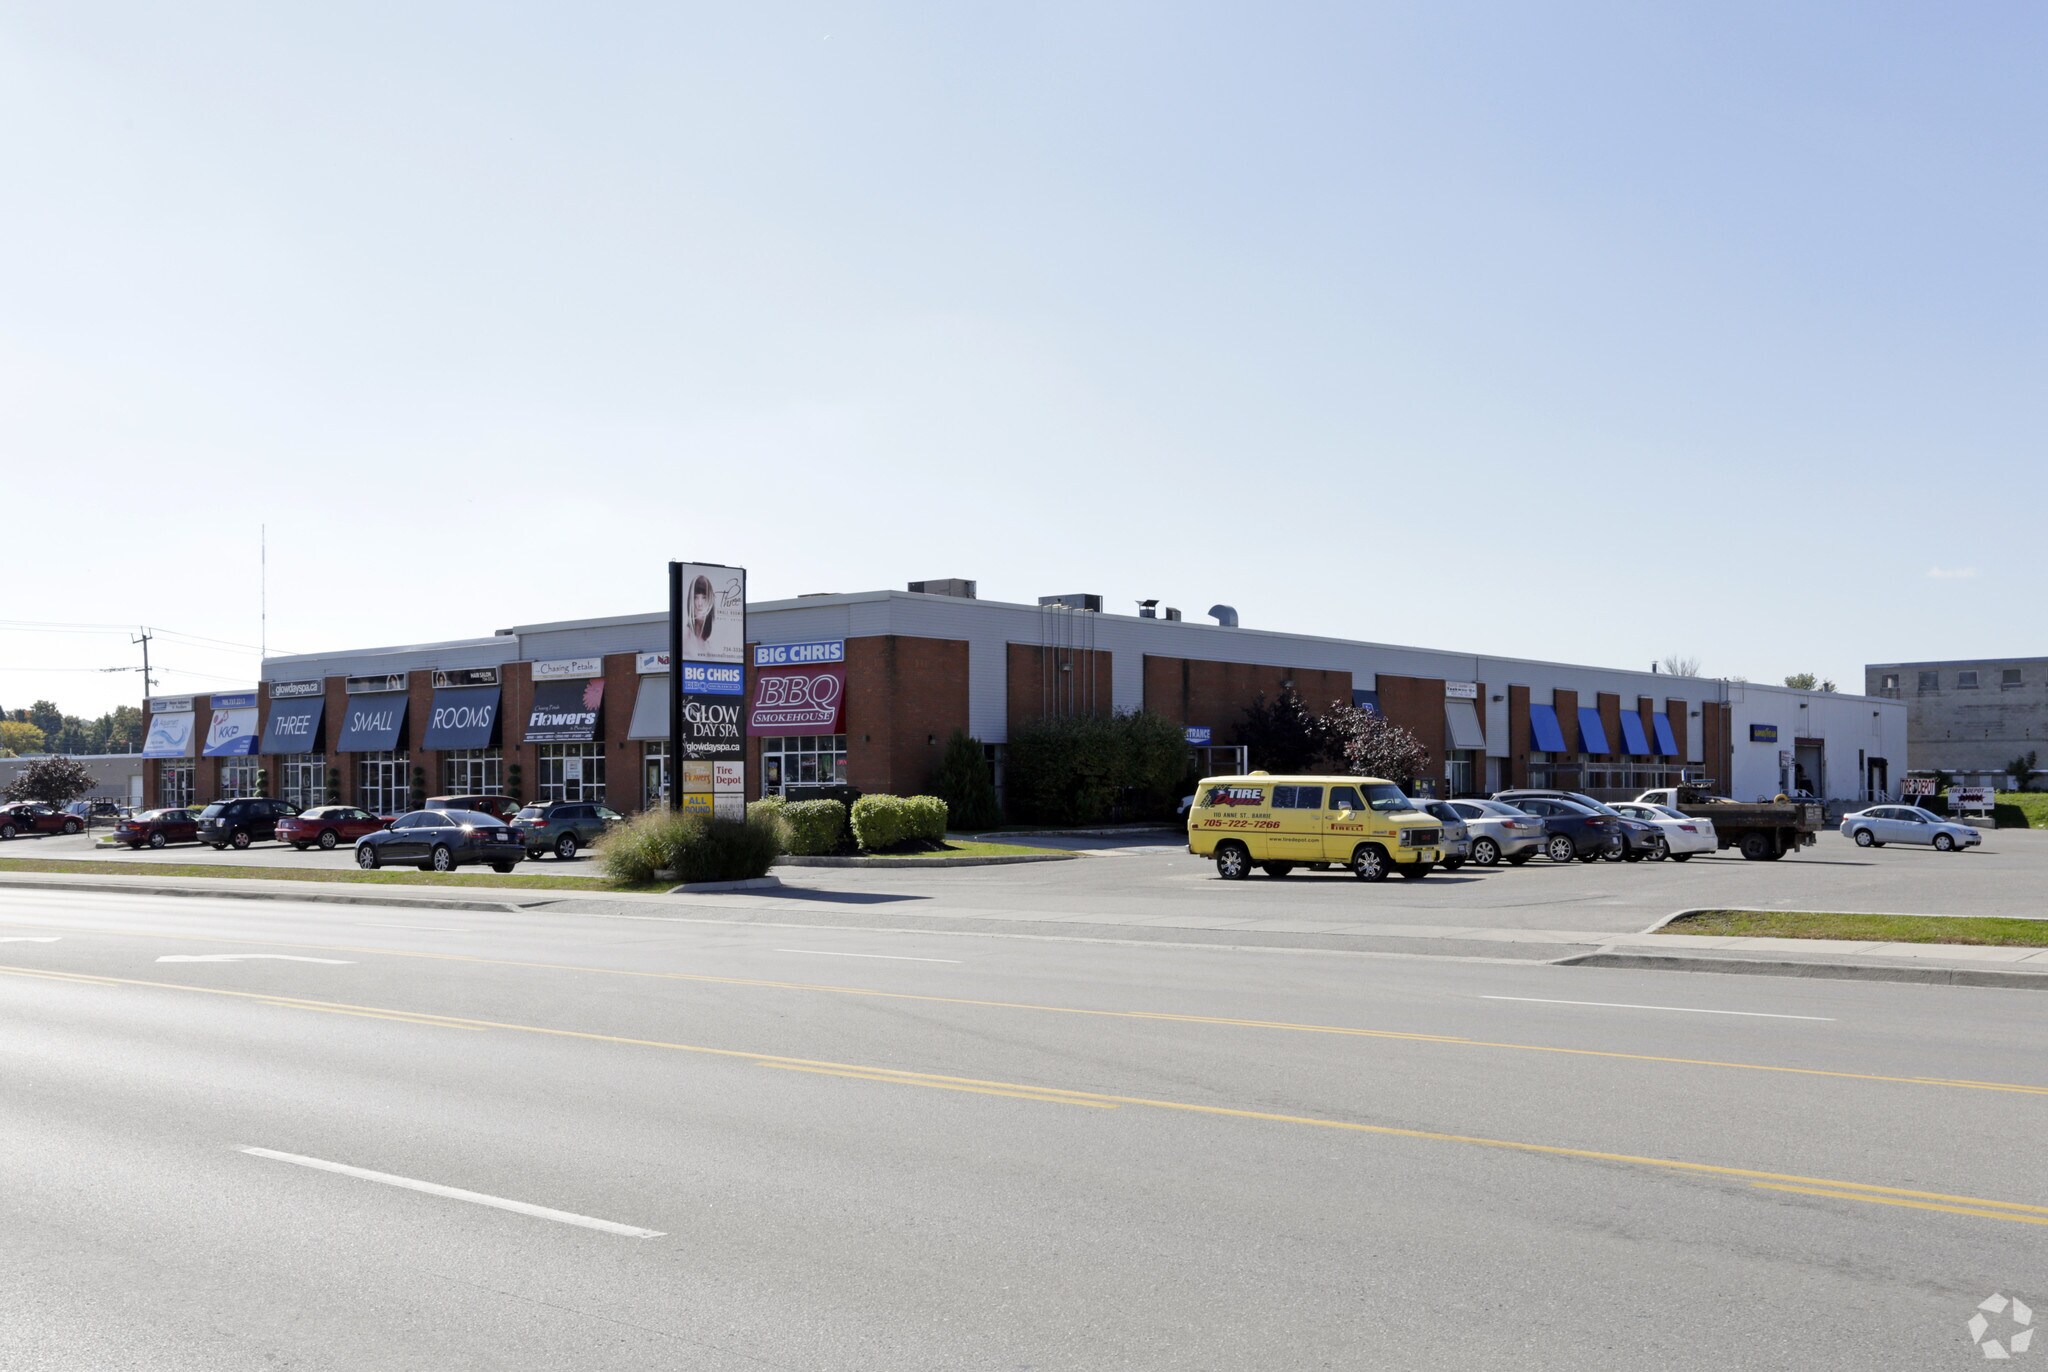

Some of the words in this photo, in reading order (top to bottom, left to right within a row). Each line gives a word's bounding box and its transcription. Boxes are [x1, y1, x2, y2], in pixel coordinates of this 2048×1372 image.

[757, 648, 787, 663] BIG
[790, 643, 841, 661] CHRIS
[540, 663, 570, 674] Chasing
[572, 661, 593, 672] Petals
[684, 667, 705, 680] BIG
[706, 668, 740, 682] CHRIS
[275, 683, 318, 696] glowdayspa.ca
[756, 674, 840, 711] BBQ
[432, 705, 492, 729] ROOMS
[685, 702, 740, 723] GLOW
[755, 711, 830, 723] SMOKEHOUSE
[275, 715, 311, 735] THREE
[351, 711, 393, 732] SMALL
[529, 712, 596, 727] Flowers
[219, 725, 240, 738] KKP
[693, 723, 719, 737] DAY
[720, 724, 739, 737] SPA
[686, 743, 740, 753] glowdayspa.ca
[716, 766, 733, 775] Tire
[716, 776, 742, 786] Depot
[1228, 788, 1262, 799] TIRE
[1203, 819, 1280, 829] 705-722-7266
[1331, 823, 1363, 831] PIRELLI
